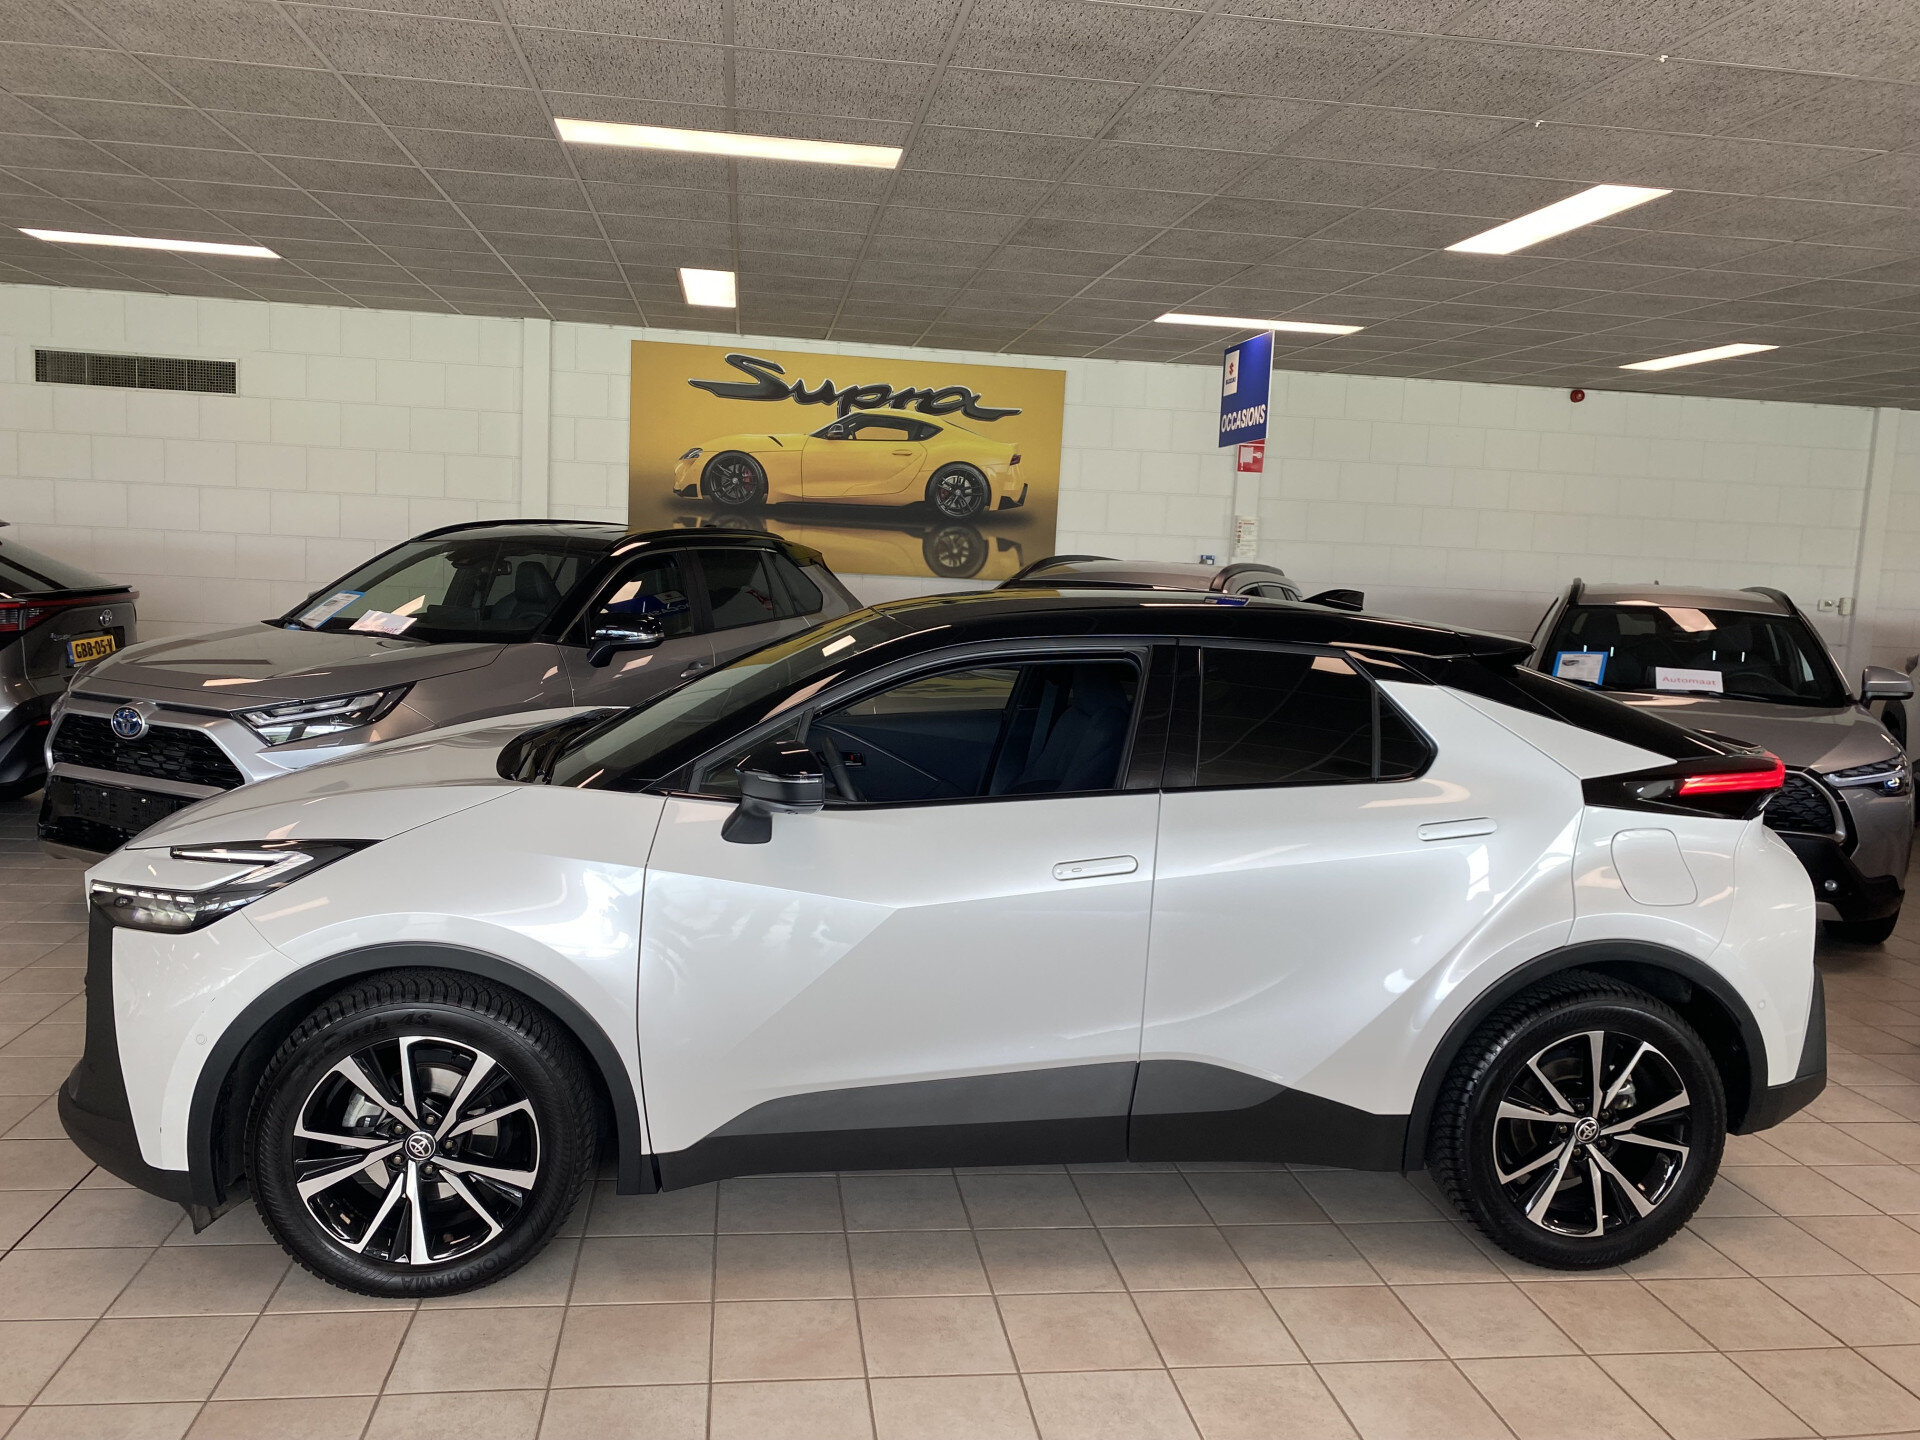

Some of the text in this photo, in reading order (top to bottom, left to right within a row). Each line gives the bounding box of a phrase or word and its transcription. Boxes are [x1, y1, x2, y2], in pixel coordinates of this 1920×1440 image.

[688, 353, 1023, 421] Supra
[1221, 403, 1267, 433] OCCASIONS
[1662, 676, 1716, 686] Automaat
[400, 1250, 508, 1289] YOKOHAMA
